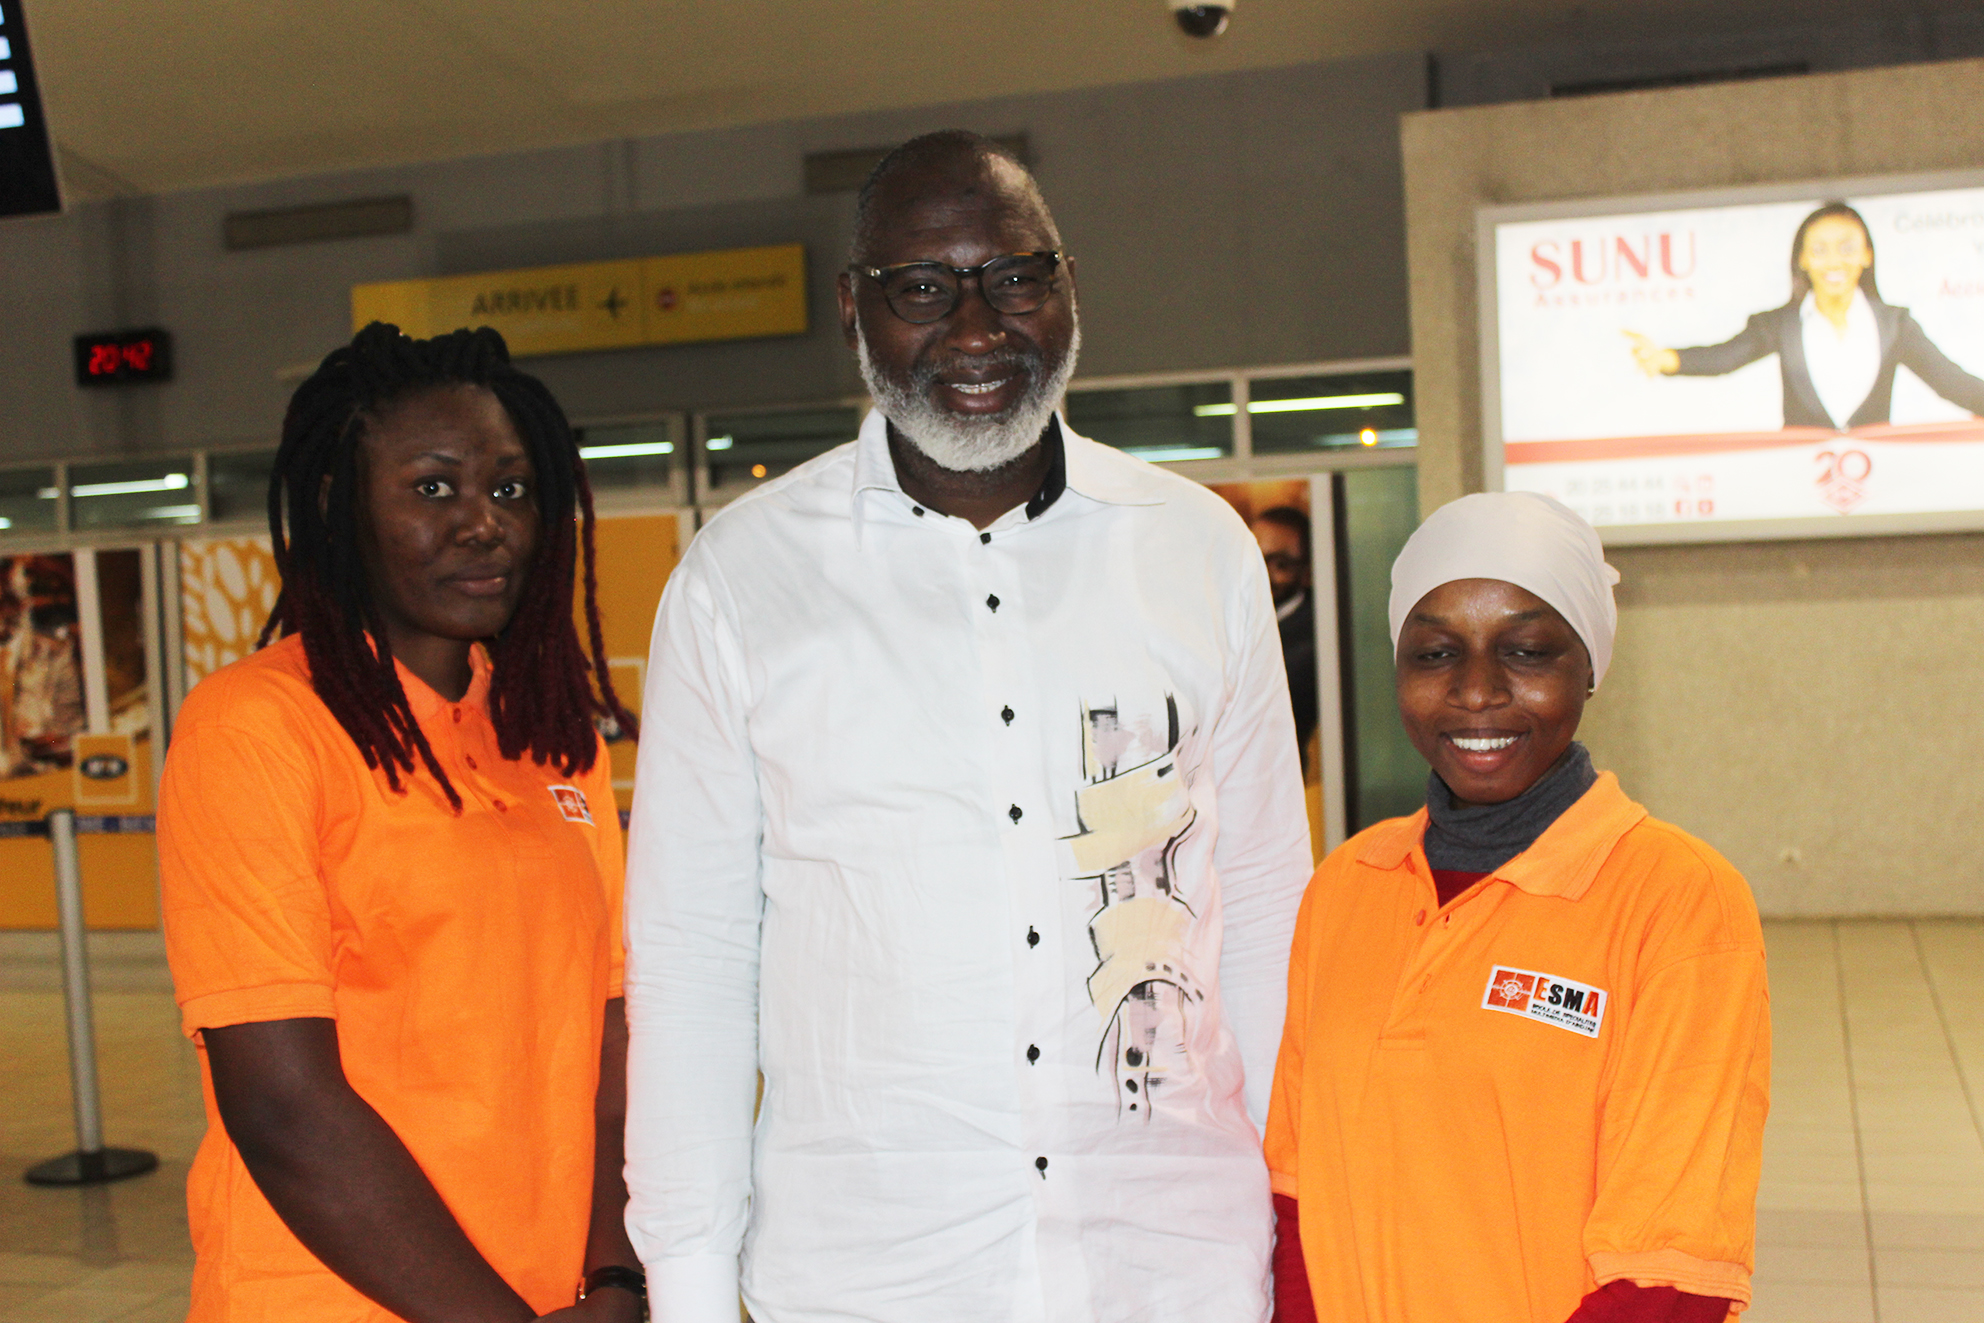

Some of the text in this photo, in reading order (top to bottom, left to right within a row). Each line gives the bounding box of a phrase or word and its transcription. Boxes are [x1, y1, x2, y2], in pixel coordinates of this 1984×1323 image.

[1528, 230, 1697, 290] SUNU
[1534, 285, 1696, 308] Assurances
[1814, 450, 1872, 485] 20
[1532, 976, 1599, 1018] ESMA
